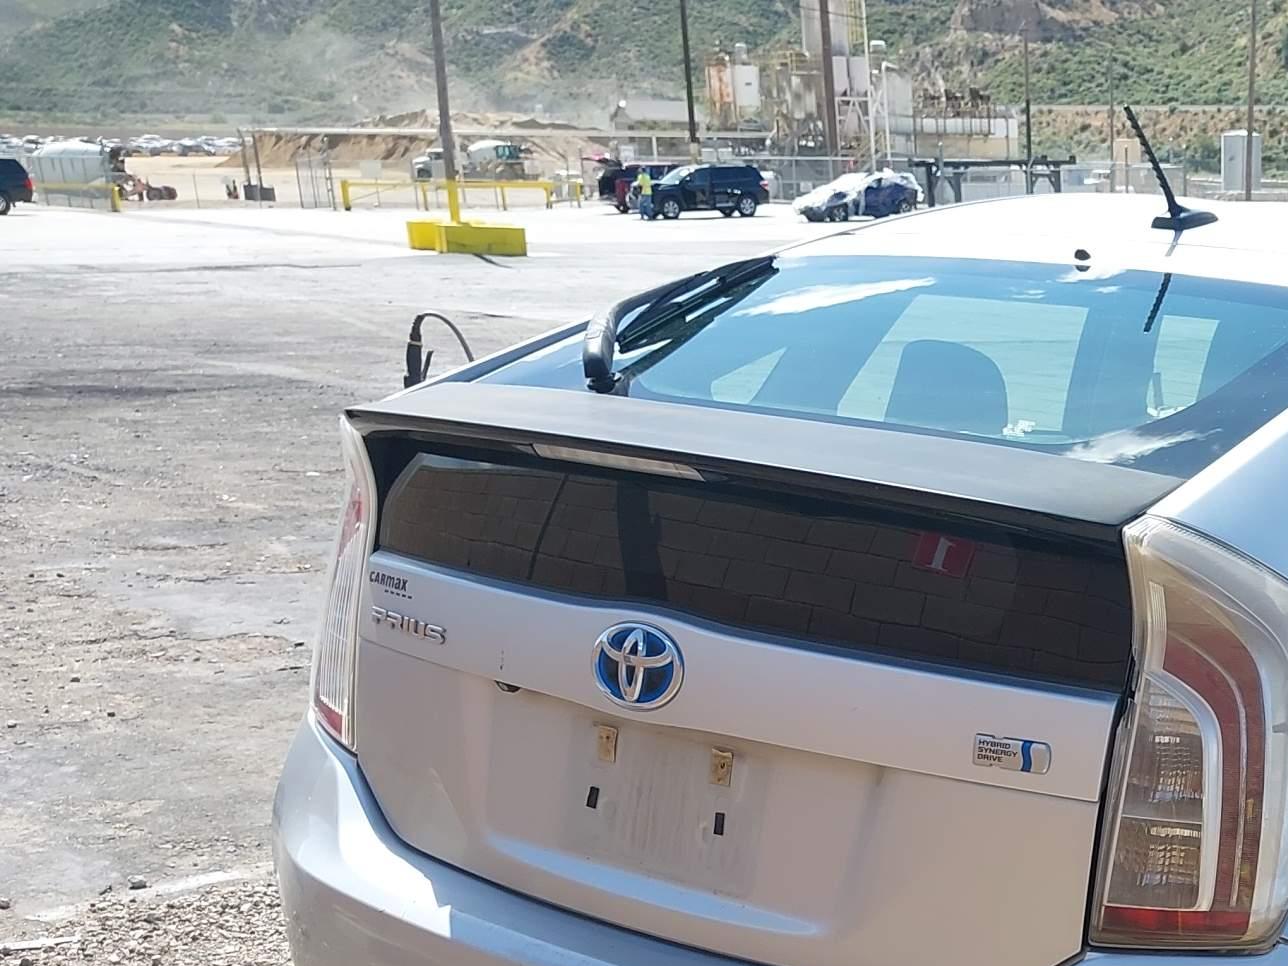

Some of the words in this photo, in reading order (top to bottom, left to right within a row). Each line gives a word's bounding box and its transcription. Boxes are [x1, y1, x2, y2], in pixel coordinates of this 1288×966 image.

[372, 605, 447, 645] PRIUS
[978, 739, 1011, 750] HYBRID
[978, 747, 1018, 757] SYNERGY
[977, 754, 1003, 762] DRIVE
